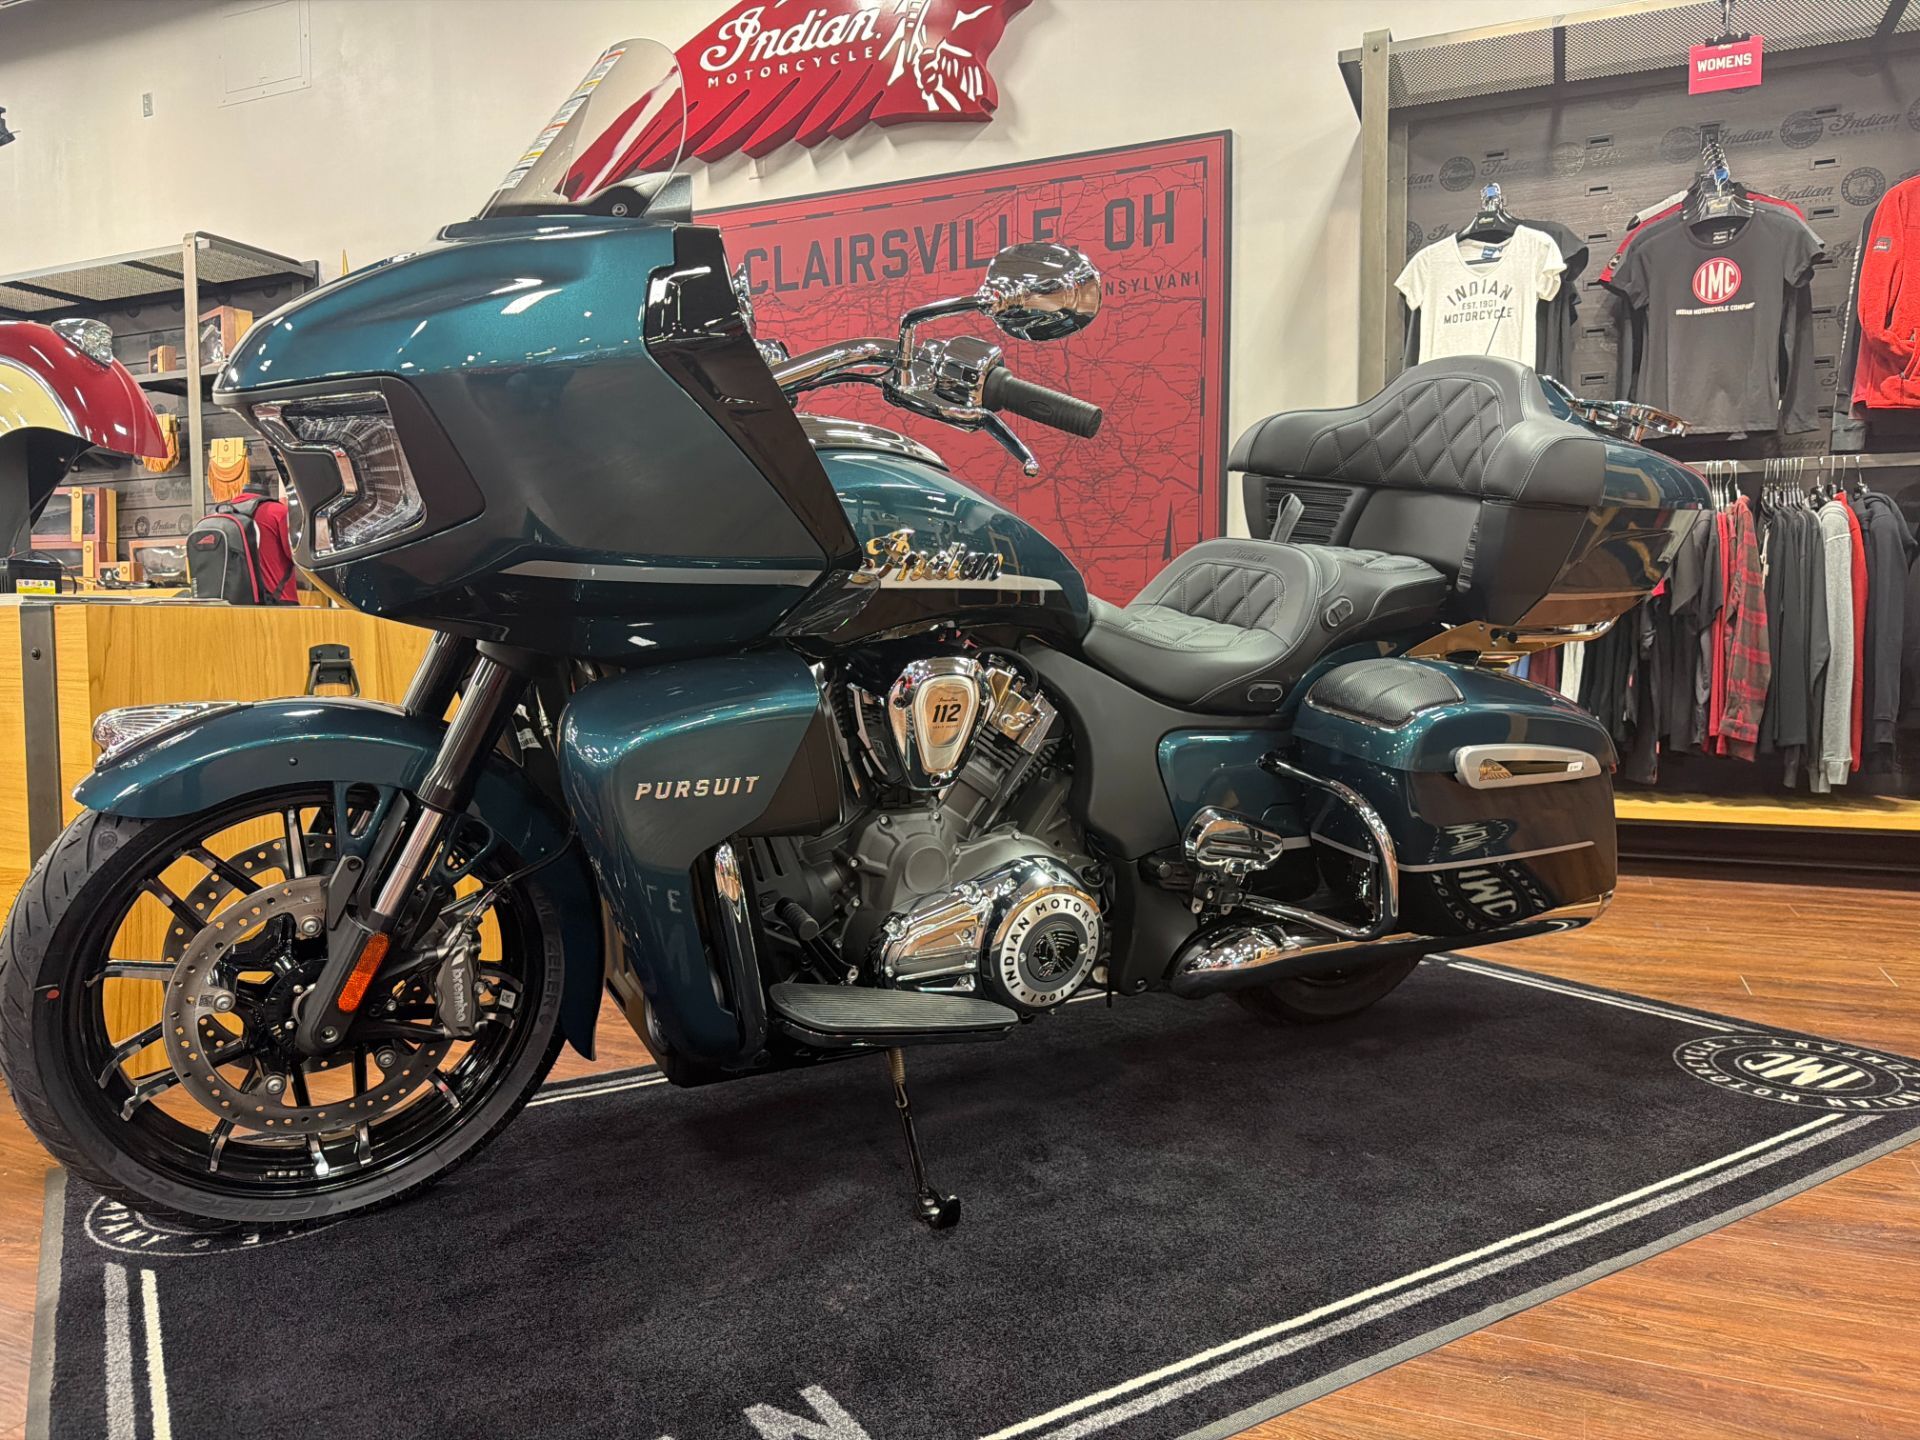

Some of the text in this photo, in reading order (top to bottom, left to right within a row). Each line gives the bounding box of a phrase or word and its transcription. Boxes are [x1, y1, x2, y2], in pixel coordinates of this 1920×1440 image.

[707, 46, 873, 88] MOTORCYCLE
[1696, 53, 1753, 73] WOMENS
[1104, 190, 1175, 251] OH
[1105, 271, 1199, 296] NSYLVANI
[1447, 279, 1513, 306] INDIAN
[1700, 262, 1735, 300] IMC
[1444, 307, 1514, 324] MOTORCYCLE
[1461, 302, 1478, 311] EST.
[848, 528, 1004, 584] Indian
[932, 703, 962, 723] 112
[634, 775, 760, 801] PURSUIT
[1004, 898, 1097, 989] INDIAN MOTORCYCLE
[451, 967, 467, 1023] brembo
[1030, 989, 1064, 1003] 1901
[1743, 1053, 1865, 1089] IMC
